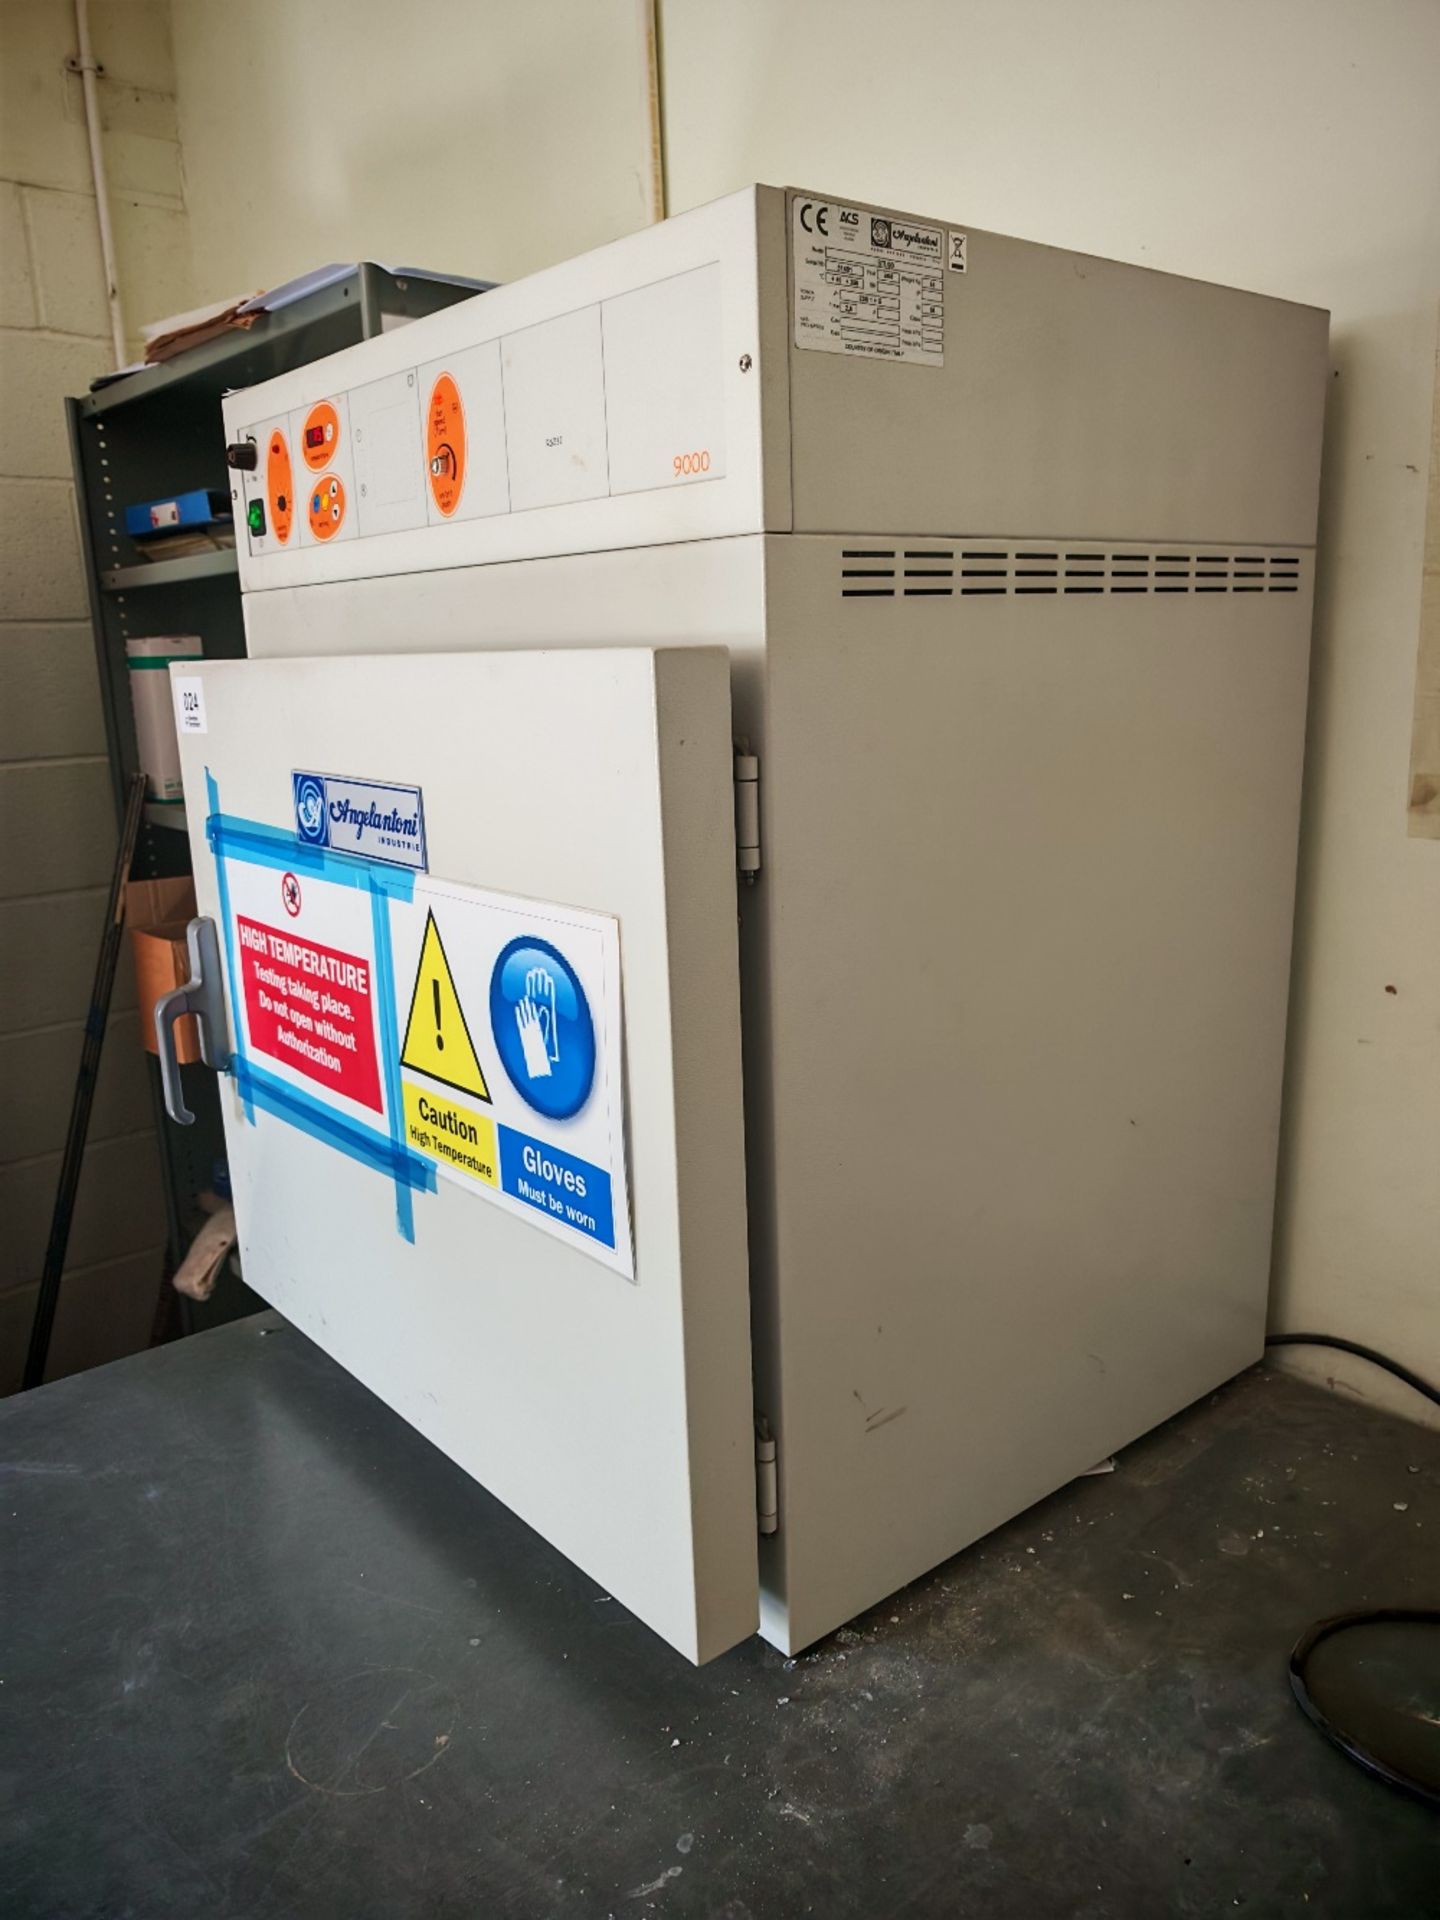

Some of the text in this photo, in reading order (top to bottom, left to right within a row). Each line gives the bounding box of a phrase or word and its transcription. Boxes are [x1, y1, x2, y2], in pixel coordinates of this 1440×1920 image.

[673, 450, 711, 477] 9000
[183, 692, 199, 711] 024
[329, 798, 418, 840] Angelantoni
[378, 836, 420, 852] INDUSTRIE
[239, 923, 368, 995] HIGH TEMPERATURE
[253, 960, 355, 1022] Testing taking place.
[258, 990, 357, 1052] Do not open without
[277, 1025, 342, 1074] Authorization
[418, 1097, 478, 1146] Caution
[410, 1124, 493, 1179] High Temperature
[523, 1145, 587, 1198] Gloves
[517, 1178, 596, 1231] Must be worn
